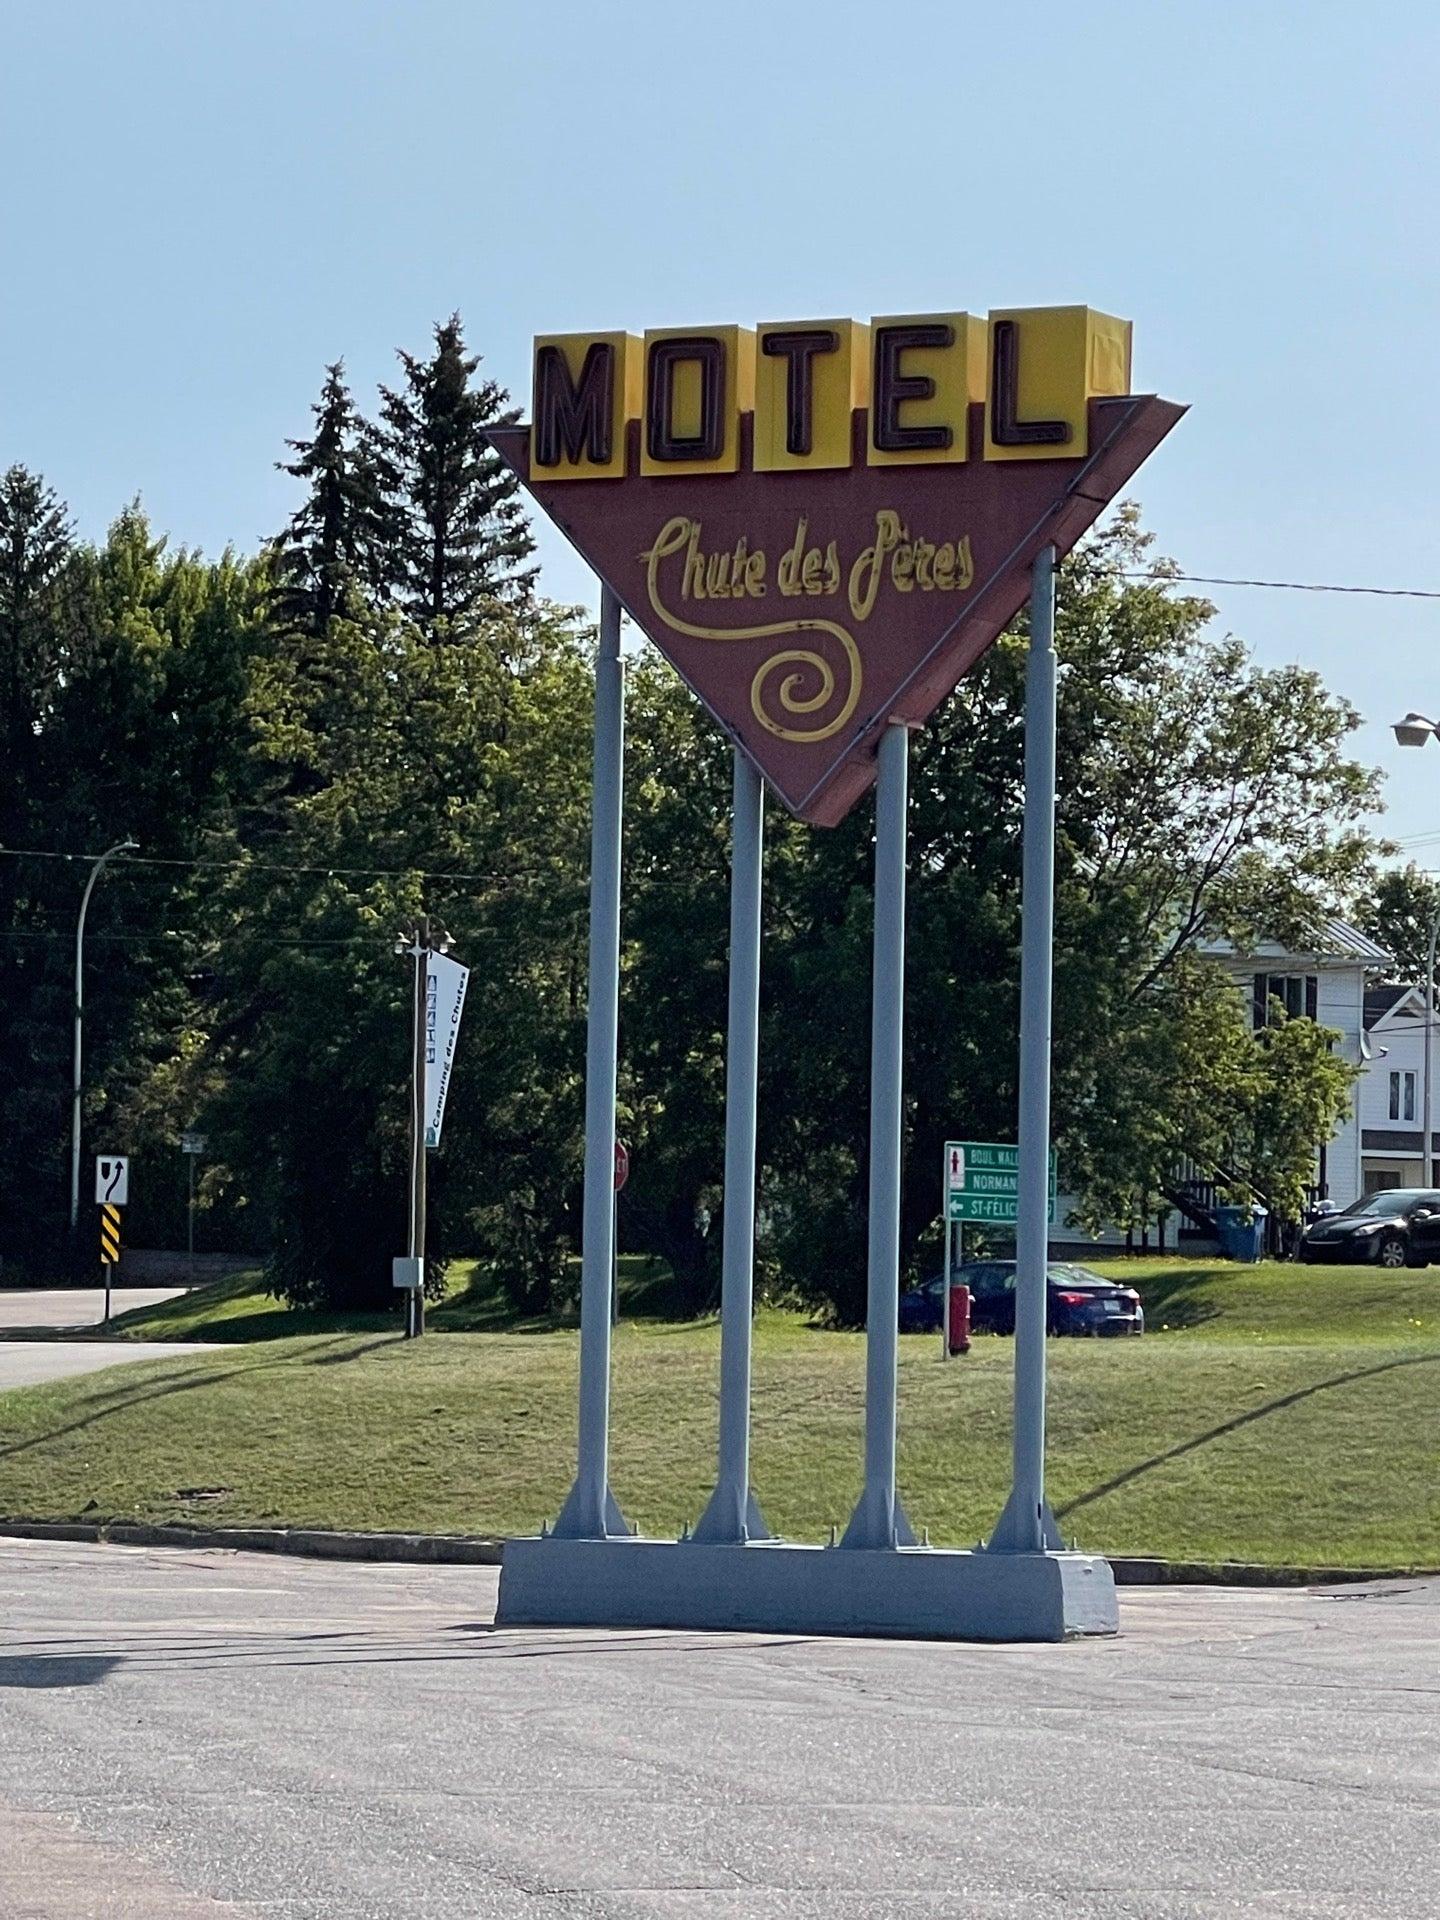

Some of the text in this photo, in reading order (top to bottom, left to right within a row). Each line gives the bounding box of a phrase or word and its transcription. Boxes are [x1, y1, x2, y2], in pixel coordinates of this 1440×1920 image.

[534, 319, 1069, 466] MOTEL
[639, 516, 766, 601] Chute
[777, 513, 840, 596] des
[432, 972, 466, 1128] Camping des Chutes
[973, 1175, 1017, 1190] NORMAN
[997, 1151, 1019, 1166] WALL
[970, 1197, 1019, 1216] ST-FÉLIC
